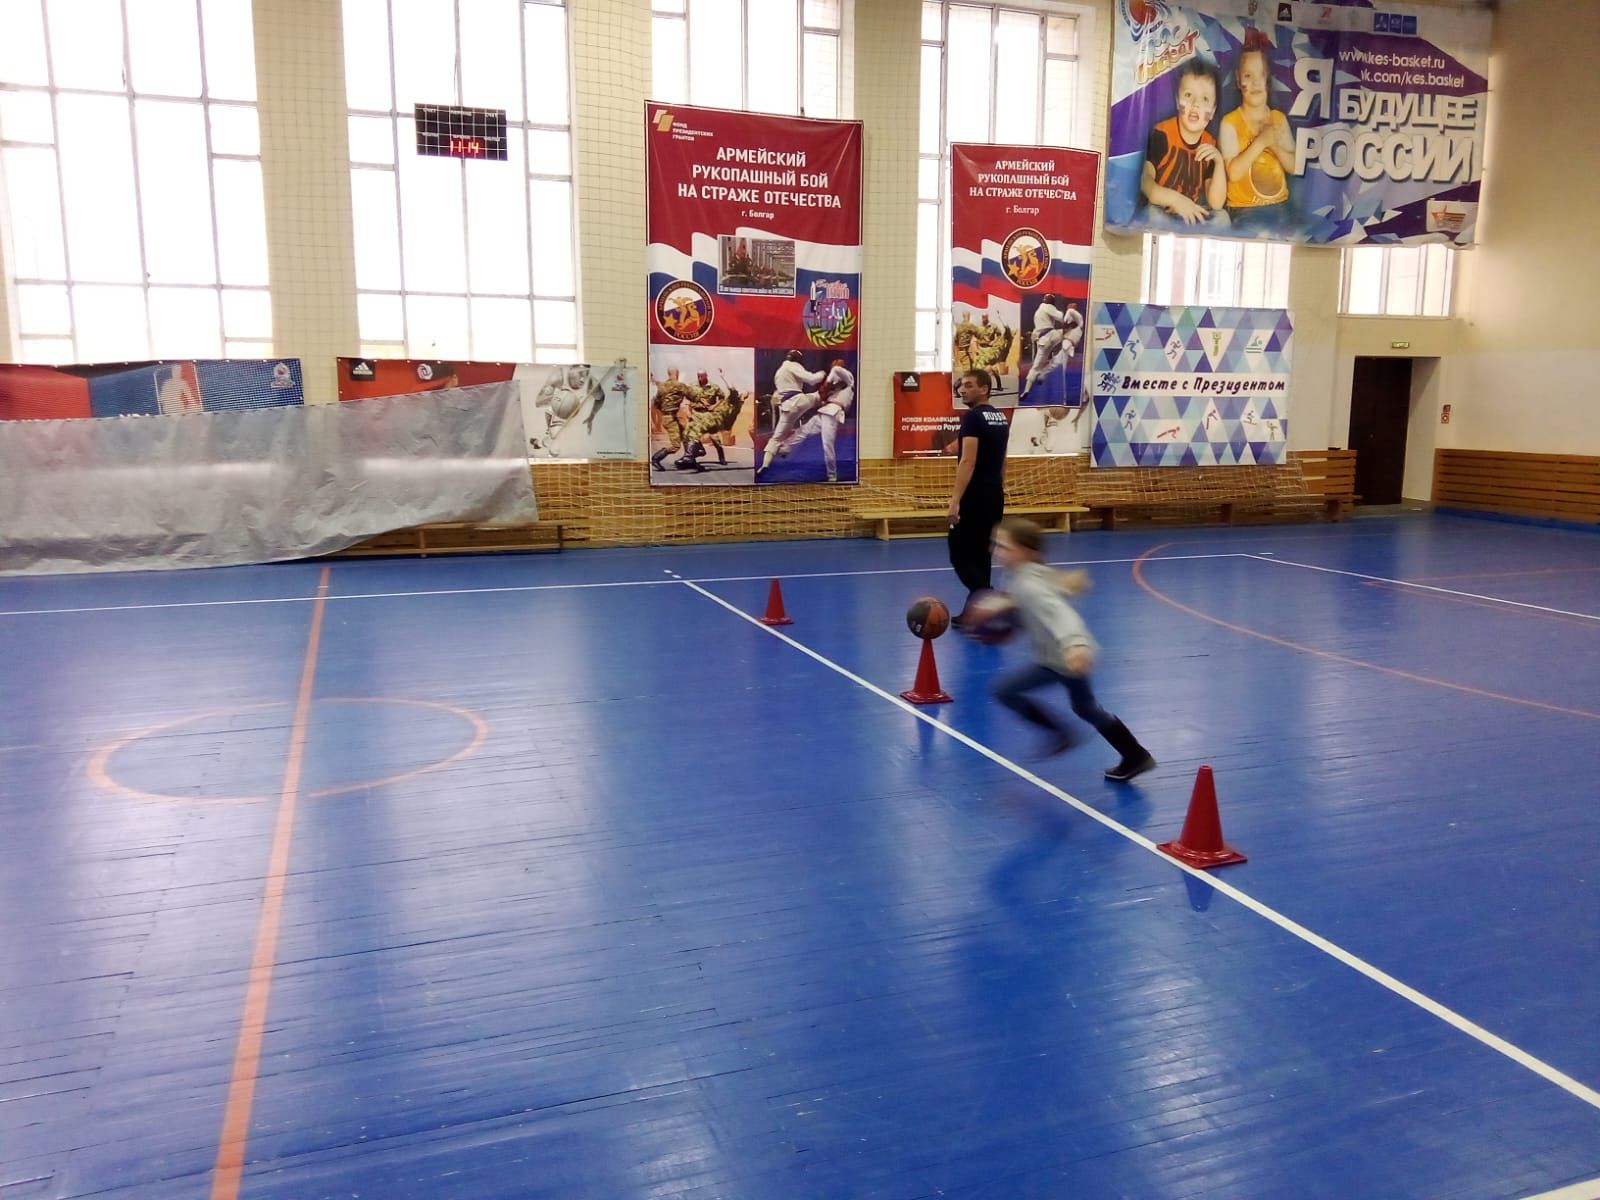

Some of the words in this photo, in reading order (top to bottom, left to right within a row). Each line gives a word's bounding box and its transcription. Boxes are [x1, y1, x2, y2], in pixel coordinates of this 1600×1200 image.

[1339, 50, 1445, 69] wwwkes-basket.ru
[1288, 57, 1334, 119] Я
[1339, 88, 1478, 133] БУДУЩЕЕ
[716, 146, 806, 167] АРМЕЙСКИЙ
[1294, 127, 1474, 184] РОССИИ
[995, 159, 1055, 172] АРМЕЙСКИЙ
[692, 164, 796, 186] РУКОПАШНЫЙ
[800, 173, 829, 188] БОЙ
[978, 173, 1050, 185] РУКОПАШНЫЙ
[1051, 174, 1070, 186] БОЙ
[677, 183, 697, 198] НА
[701, 185, 760, 203] СТРАЖЕ
[764, 190, 841, 208] ОТЕЧЕСТВА
[969, 186, 984, 197] НА
[985, 187, 1023, 198] СТРАЖЕ
[749, 209, 775, 220] Болгар
[1013, 204, 1039, 216] Болгар
[1121, 375, 1177, 390] Вместе
[1182, 379, 1189, 390] с
[1193, 377, 1285, 395] Президентом
